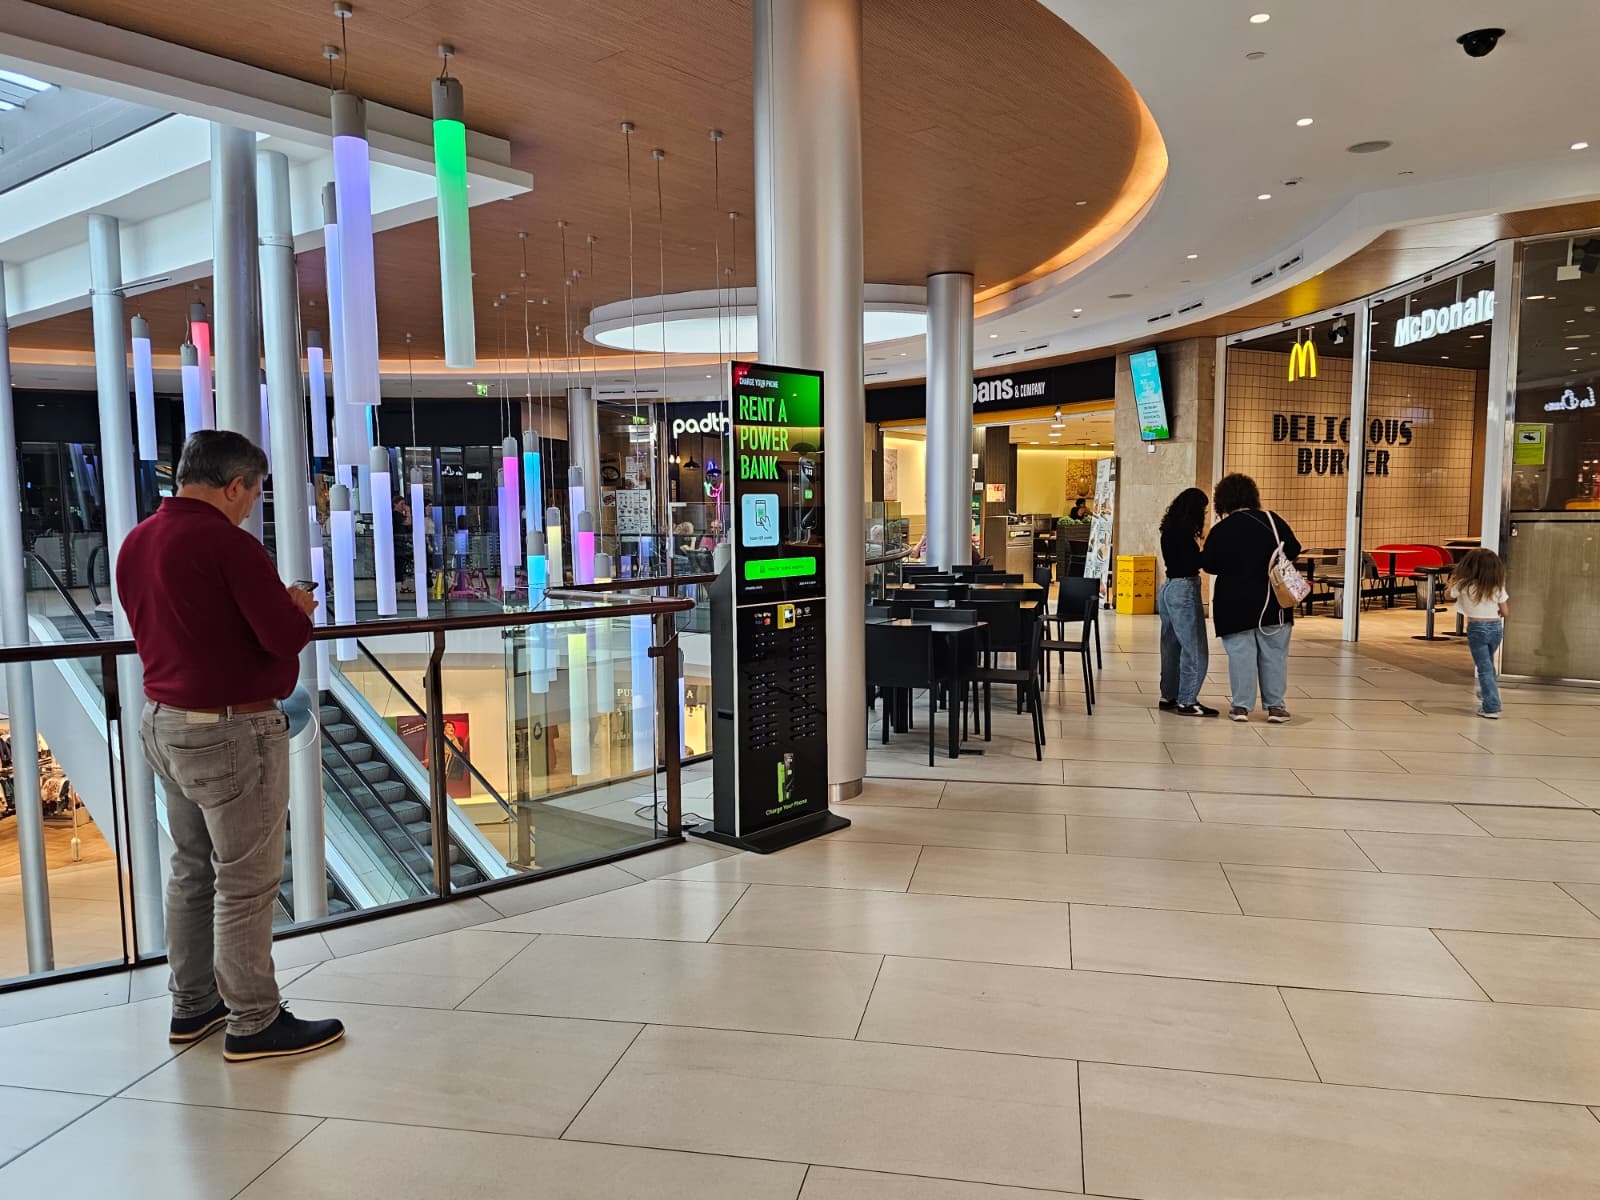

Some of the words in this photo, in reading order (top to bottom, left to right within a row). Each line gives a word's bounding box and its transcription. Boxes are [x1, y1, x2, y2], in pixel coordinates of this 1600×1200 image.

[1014, 384, 1019, 398] &
[1020, 381, 1046, 397] COMPANY
[739, 395, 775, 422] RENT
[778, 398, 787, 423] A
[740, 425, 789, 452] POWER
[1272, 413, 1413, 446] DELICOUS
[740, 454, 779, 480] BANK
[1297, 447, 1390, 477] BURER
[765, 806, 783, 816] Charge
[783, 802, 794, 811] Your
[793, 798, 808, 808] Phone
